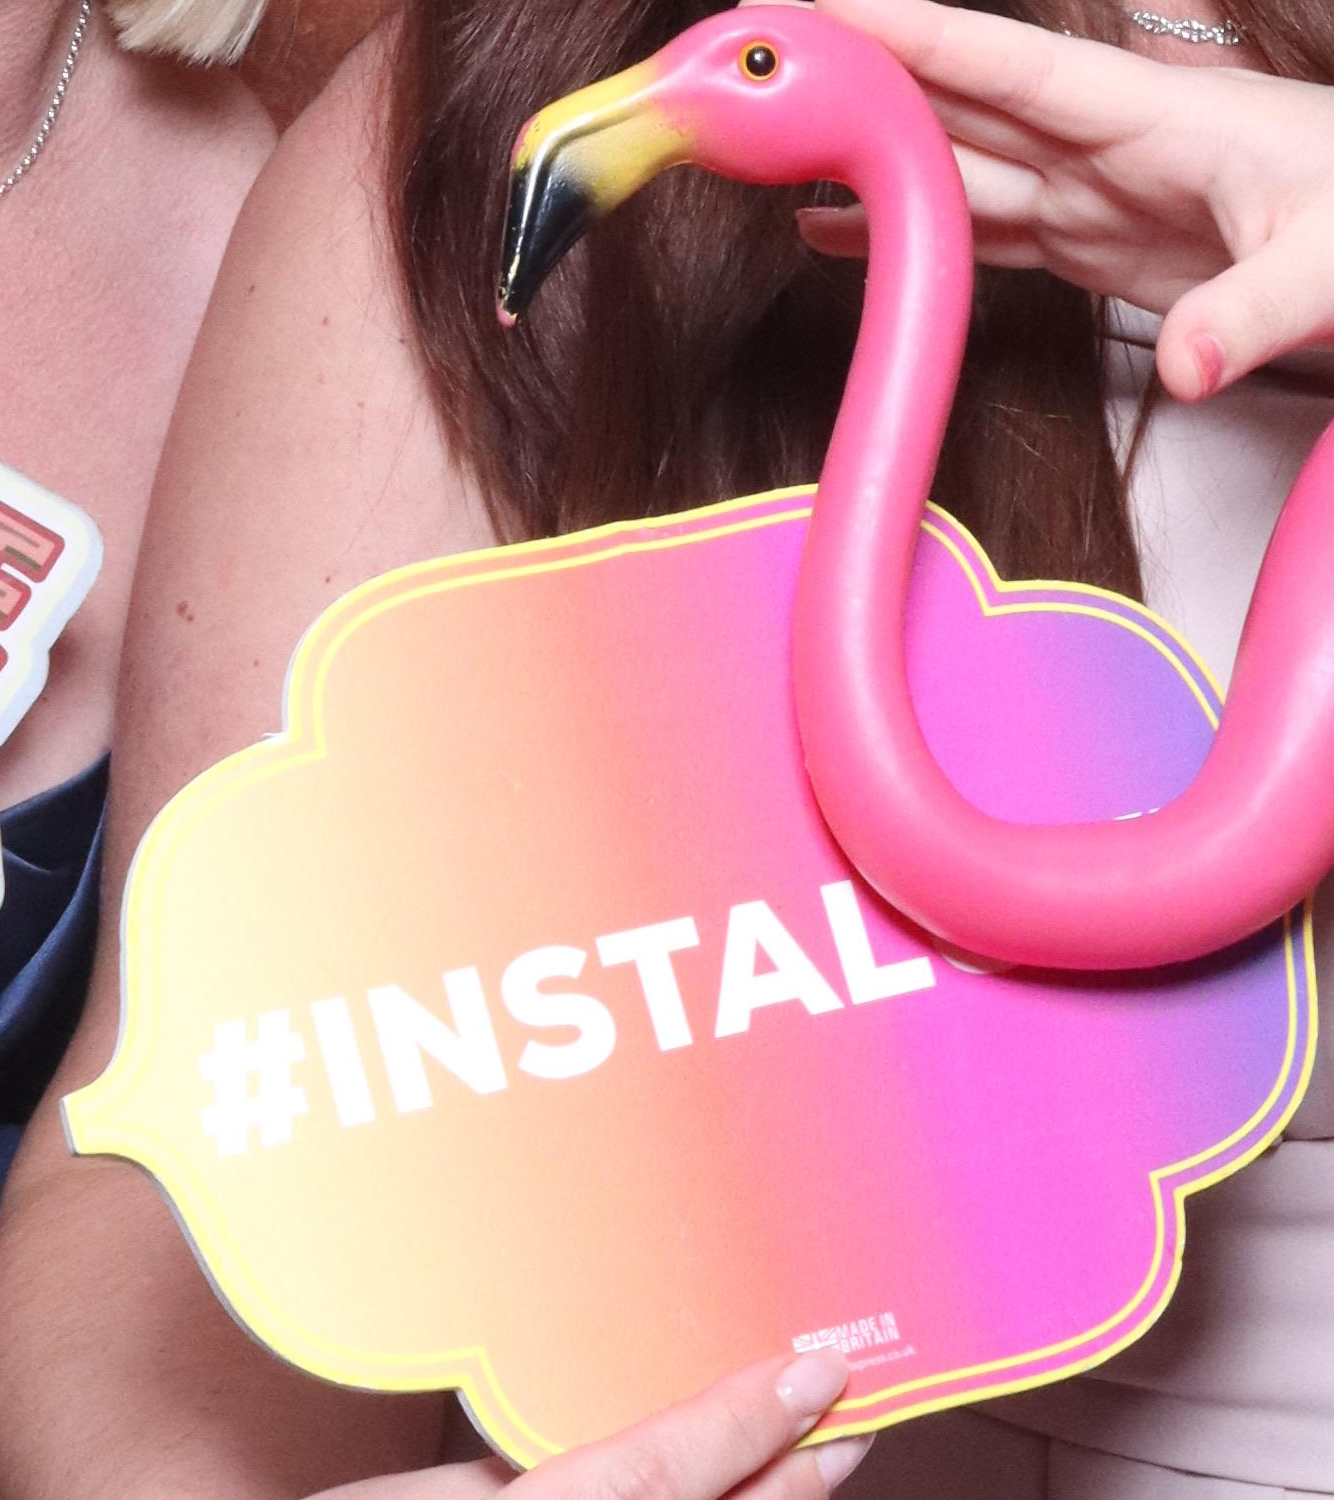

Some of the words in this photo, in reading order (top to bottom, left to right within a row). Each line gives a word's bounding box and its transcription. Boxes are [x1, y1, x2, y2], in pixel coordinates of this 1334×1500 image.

[196, 806, 1161, 1158] #INSTAL
[835, 1316, 875, 1337] MADE
[879, 1312, 896, 1327] IN
[841, 1327, 899, 1353] BRITAIN
